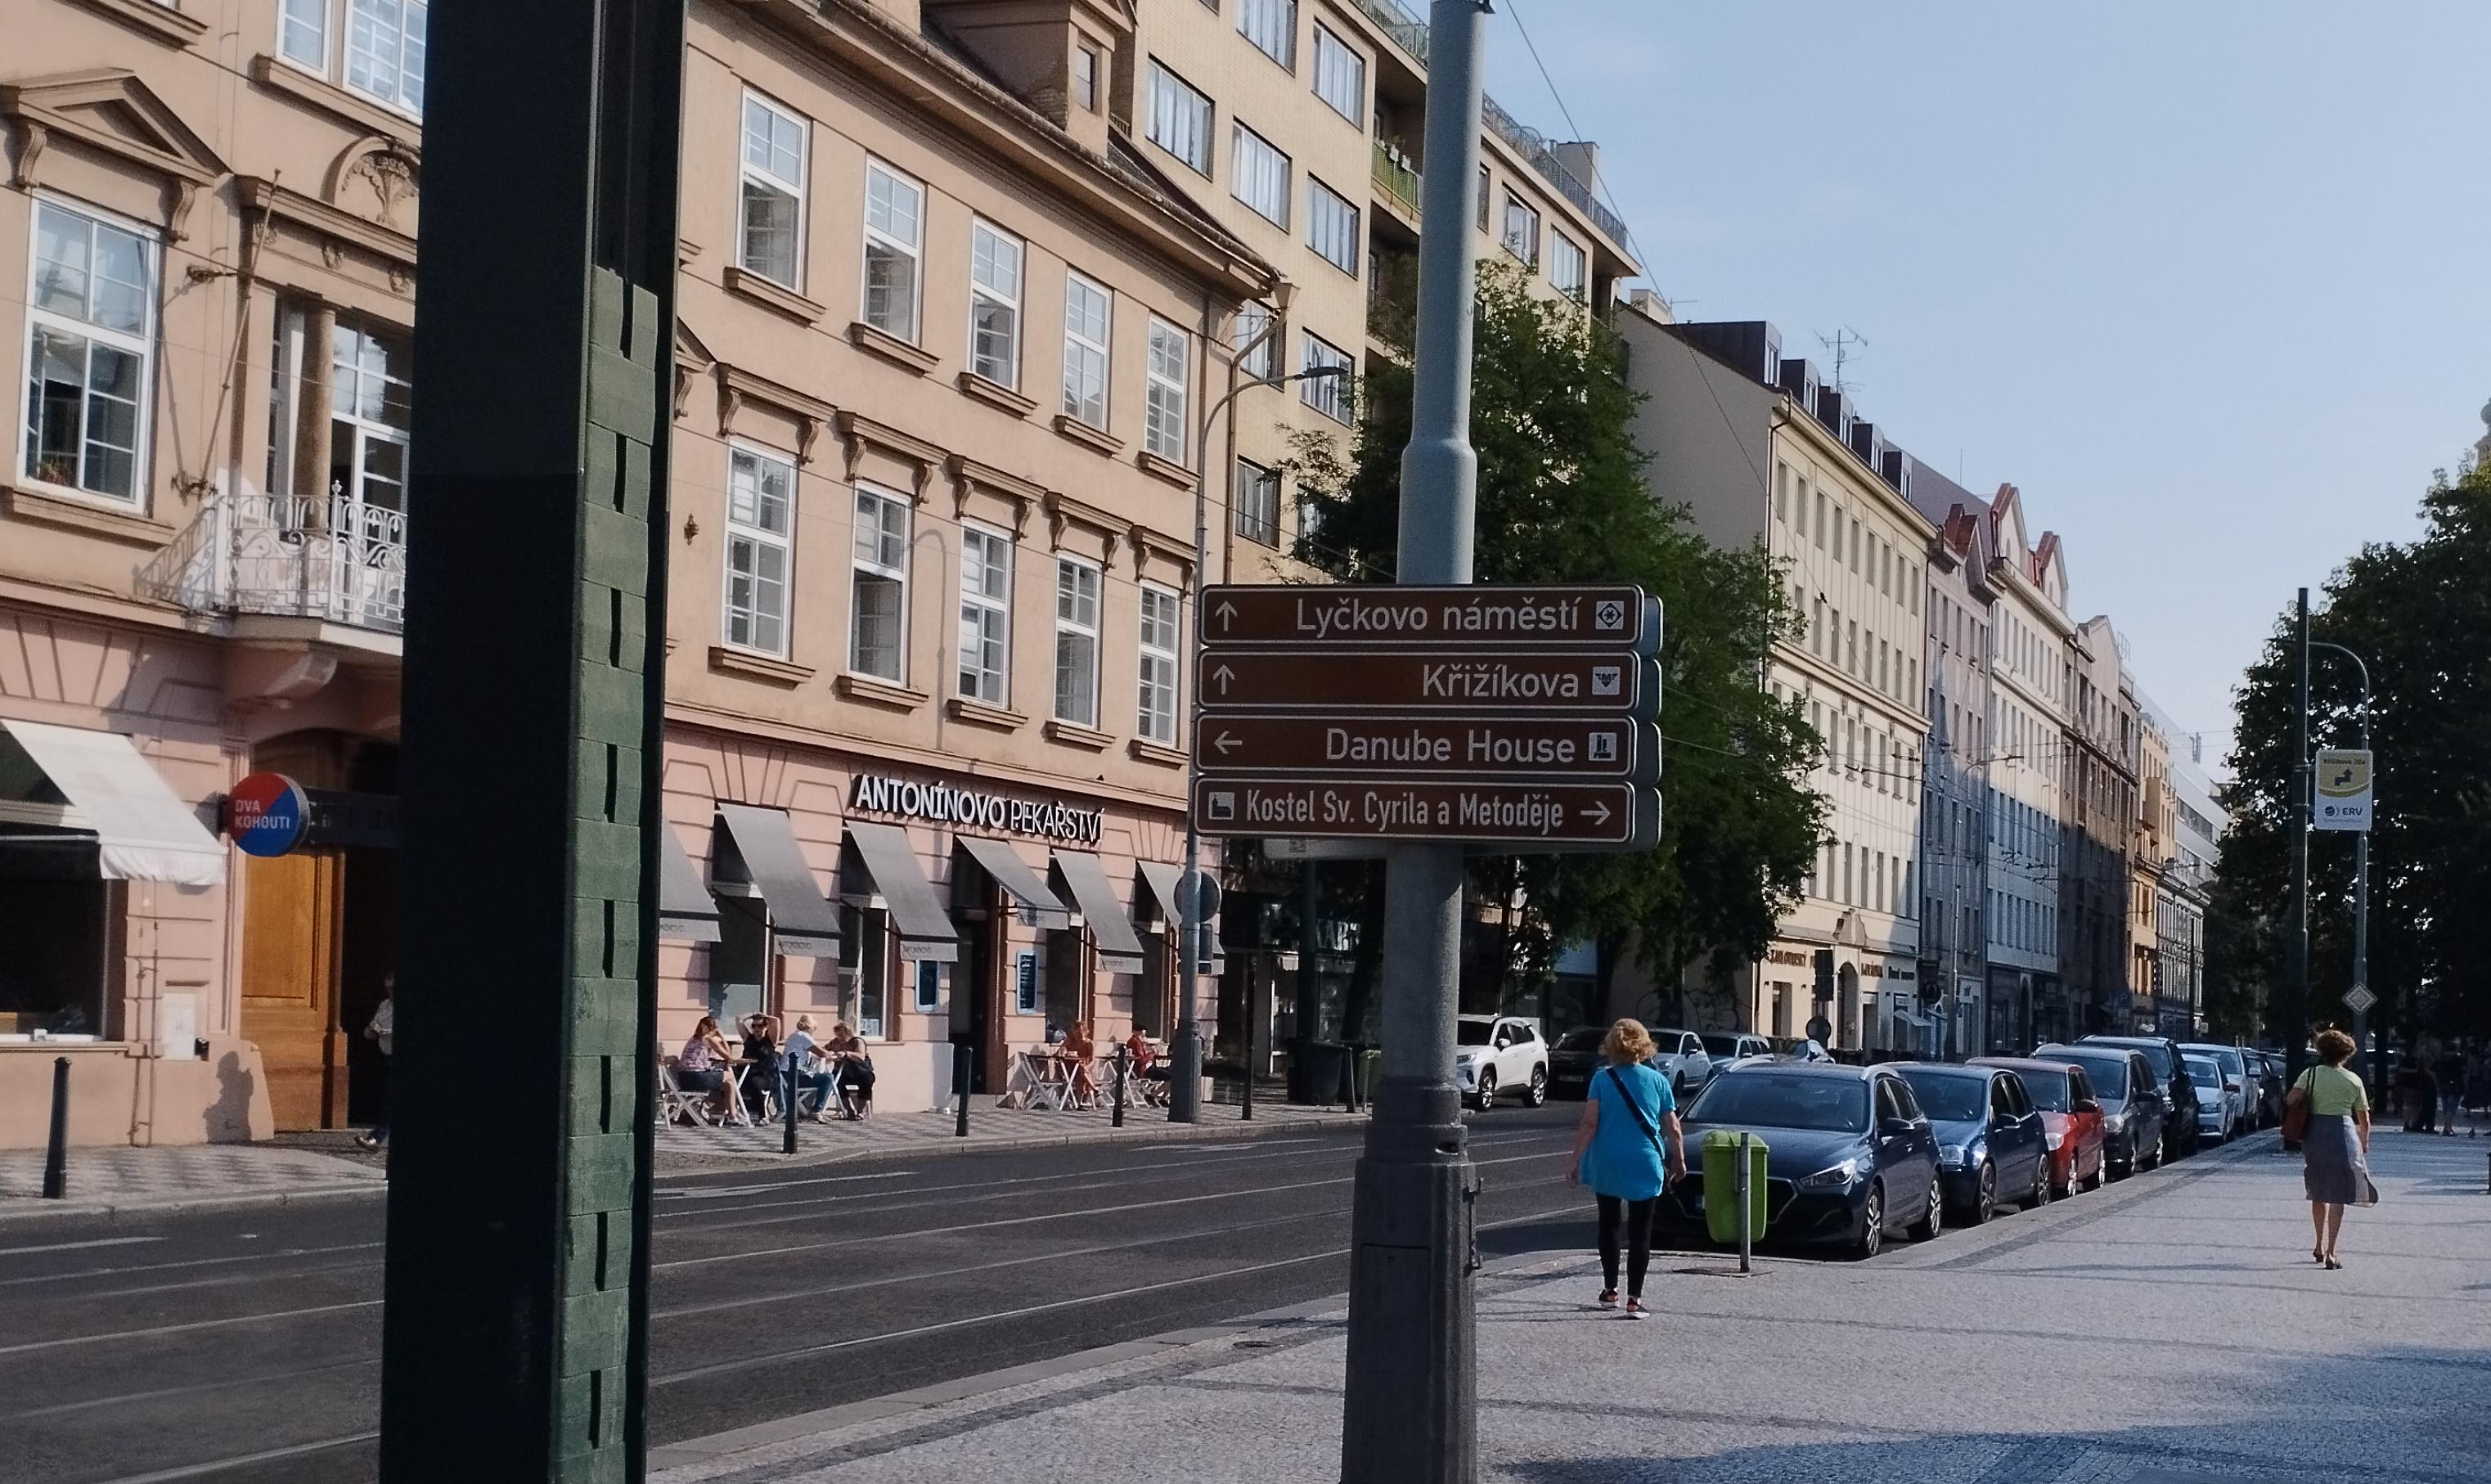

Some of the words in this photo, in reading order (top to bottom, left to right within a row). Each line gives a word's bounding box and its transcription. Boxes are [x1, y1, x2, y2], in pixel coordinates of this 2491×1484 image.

[1297, 596, 1428, 639] Lyčkovo
[1443, 596, 1583, 632] náměstí
[1422, 662, 1580, 699] Křižíkova
[1326, 727, 1451, 762] Danube
[1467, 730, 1576, 764] House
[236, 800, 260, 812] DVA
[236, 816, 290, 830] KOHOUTI
[856, 774, 1005, 828] ANTONÍNOVO
[1010, 798, 1105, 843] PEKAŘSTVÍ
[1247, 789, 1315, 823] Kostel
[1323, 792, 1354, 824] Sv.
[1364, 792, 1429, 831] Cyrila
[1437, 802, 1448, 825] a
[1459, 794, 1564, 836] Metoděje
[2342, 807, 2362, 816] ERV
